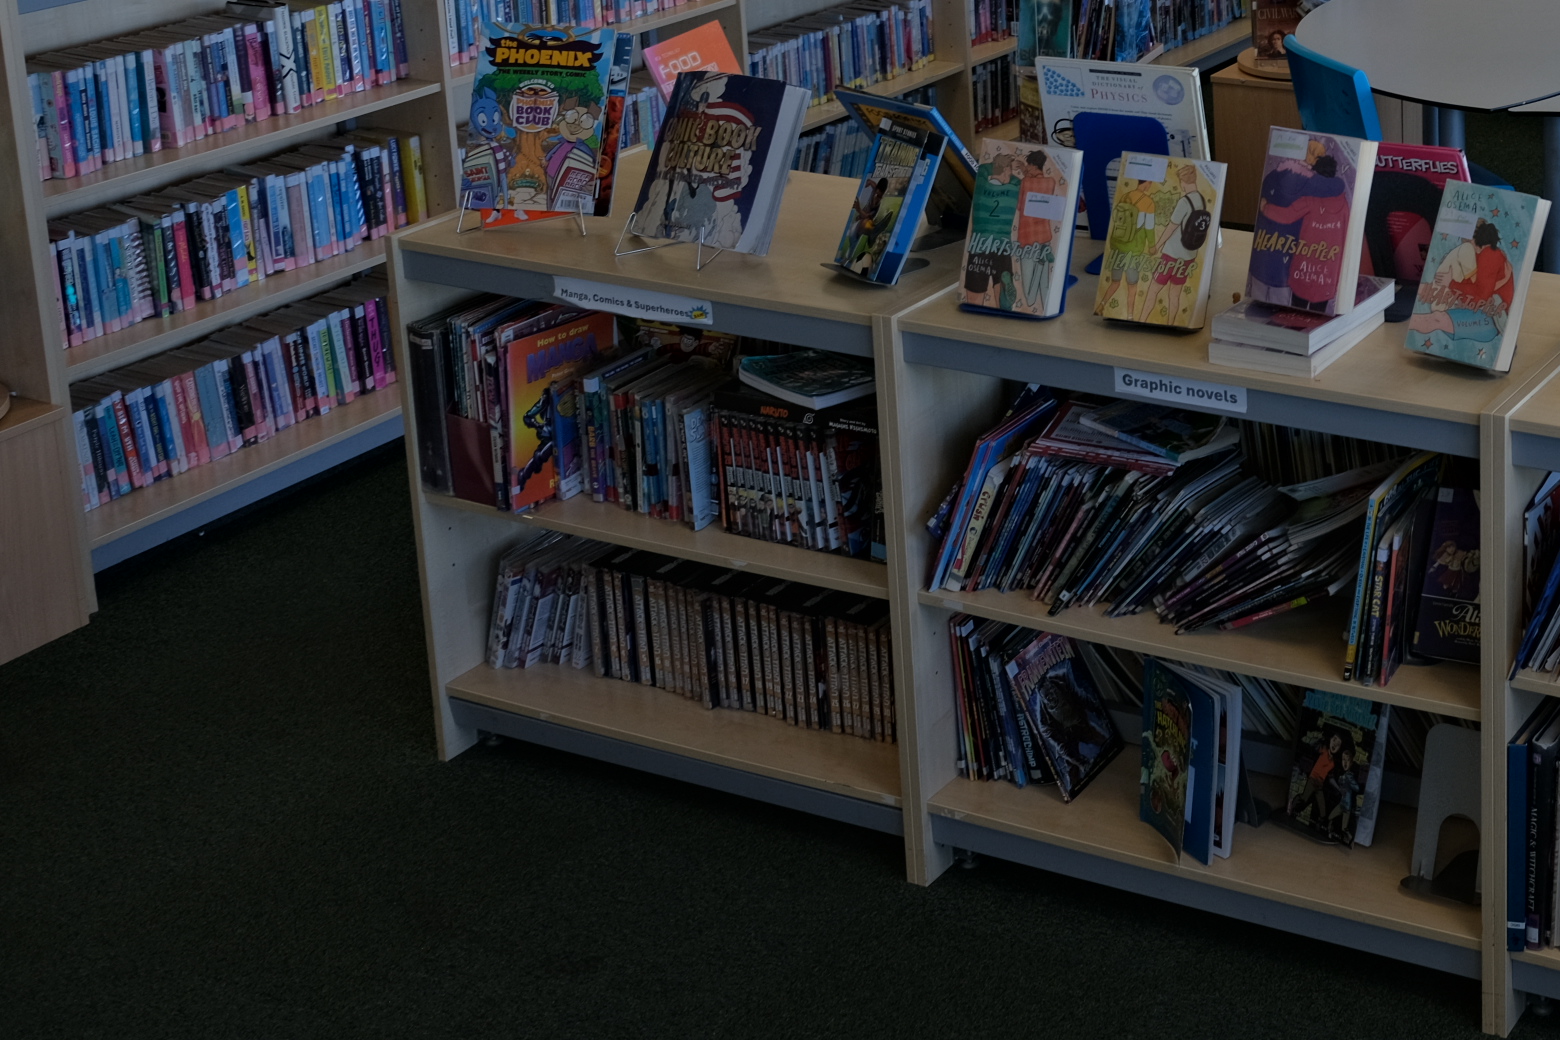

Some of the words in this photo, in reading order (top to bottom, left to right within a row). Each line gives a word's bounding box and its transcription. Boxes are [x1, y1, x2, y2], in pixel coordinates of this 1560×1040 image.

[500, 39, 518, 48] the
[495, 48, 593, 67] PHOENIX
[1095, 75, 1108, 83] THE
[1109, 76, 1138, 84] VISUAL
[1090, 88, 1148, 104] PHYSICS
[516, 106, 553, 116] BOOK
[515, 115, 551, 126] CLUB
[982, 188, 1011, 198] VOLUME
[1452, 190, 1483, 200] ALICE
[988, 200, 1000, 218] 2
[968, 232, 1051, 261] HEARTSTOPPER
[1253, 228, 1340, 261] HEARTSTOPPER
[972, 255, 994, 266] ALICE
[1104, 250, 1198, 278] HEARTSTOPPER
[1299, 261, 1329, 273] ALICE
[968, 264, 998, 276] OSEMAN
[1293, 270, 1332, 286] OSEMAN
[560, 287, 591, 304] Manga,
[593, 292, 625, 308] Comics
[626, 298, 633, 308] &
[634, 300, 689, 318] Superheroes
[537, 336, 554, 348] How
[556, 332, 566, 342] to
[566, 323, 590, 338] draw
[1122, 373, 1183, 397] Graphic
[1186, 383, 1238, 404] novels
[759, 405, 789, 419] NARUTO
[1374, 575, 1383, 598] STAR
[1371, 599, 1383, 618] CAT
[1530, 807, 1538, 839] MAGIC
[1530, 840, 1536, 848] &
[1528, 851, 1536, 912] WITCHCRAFT
